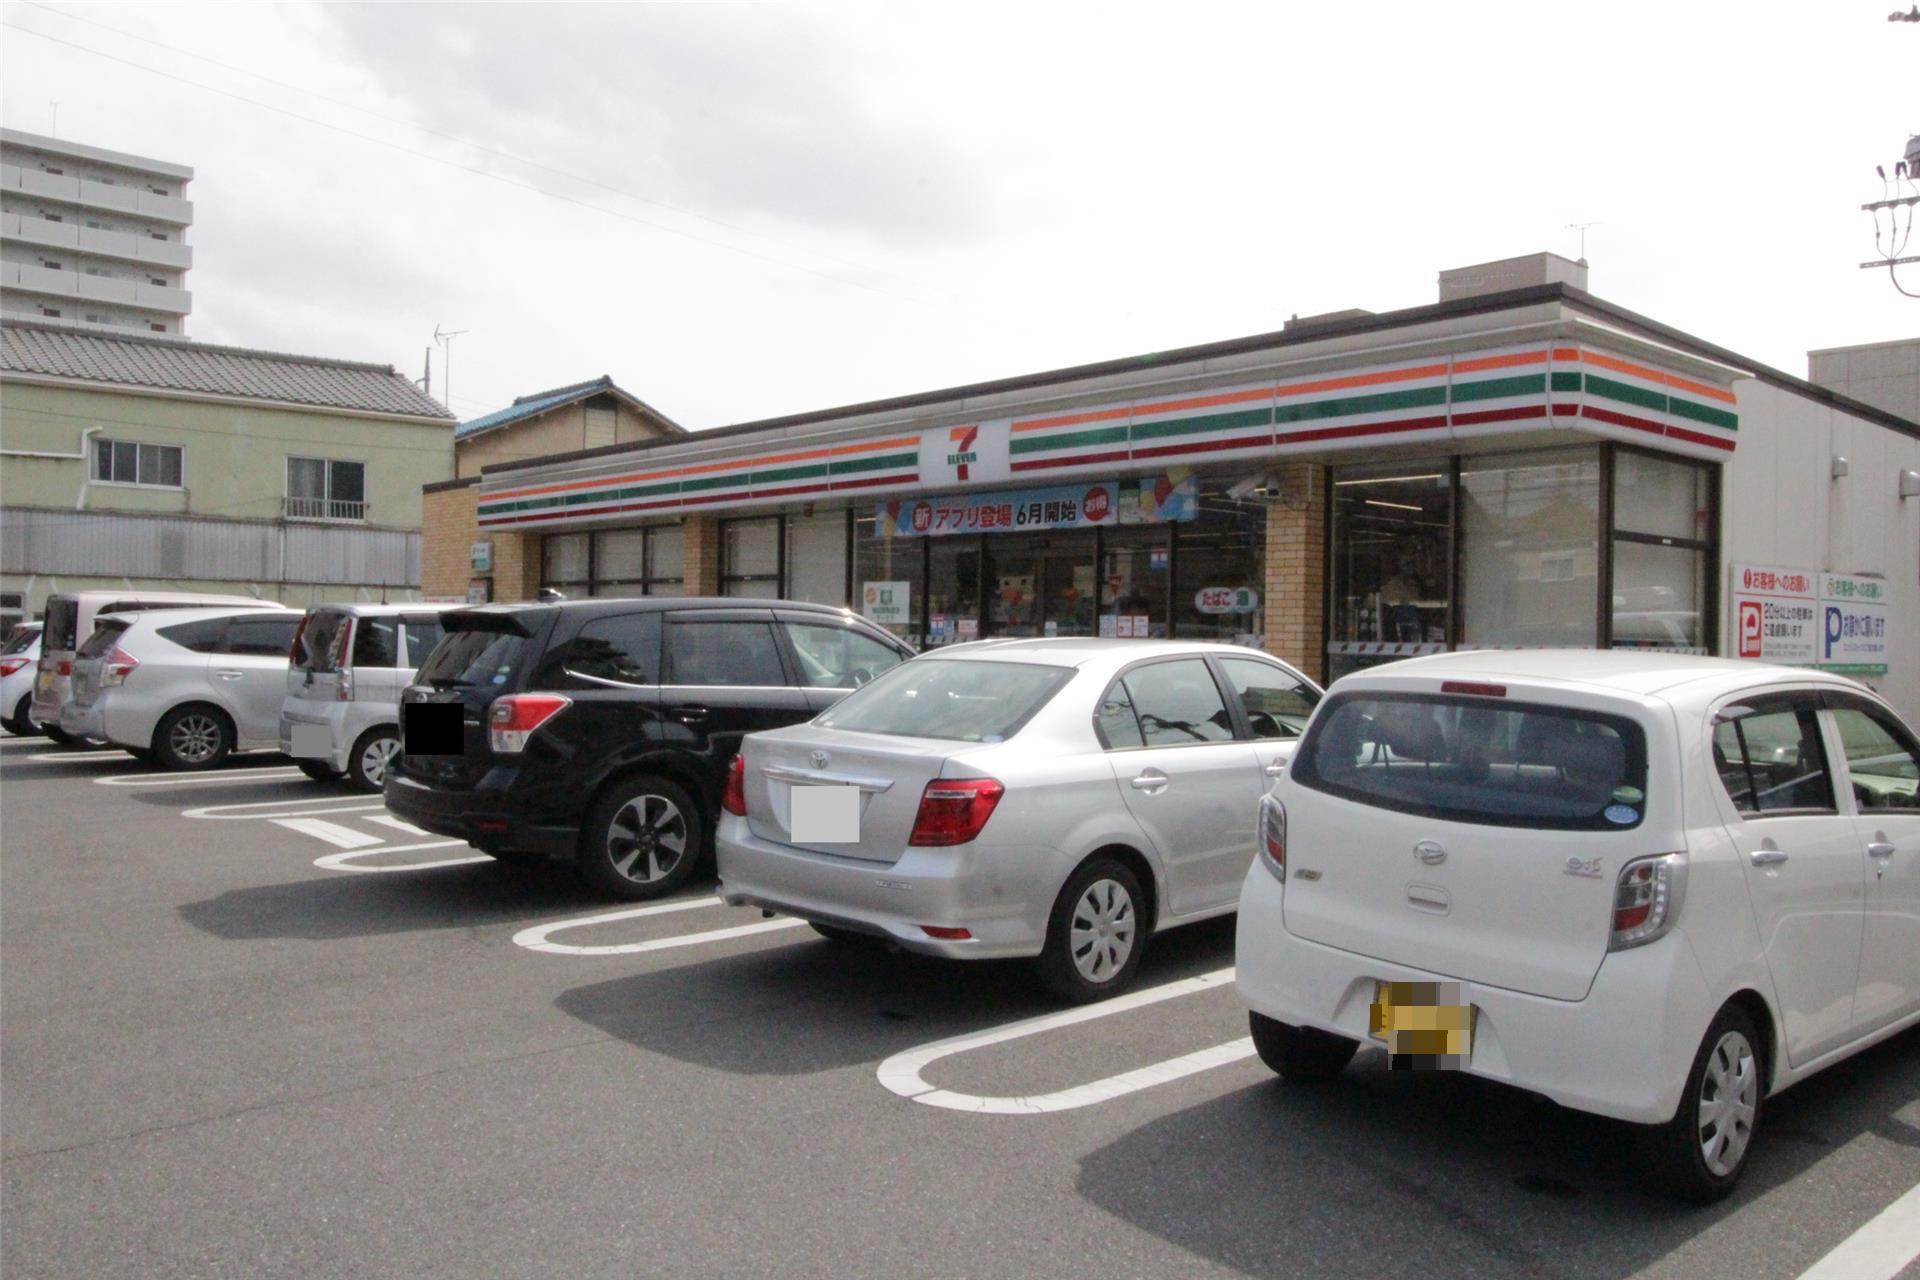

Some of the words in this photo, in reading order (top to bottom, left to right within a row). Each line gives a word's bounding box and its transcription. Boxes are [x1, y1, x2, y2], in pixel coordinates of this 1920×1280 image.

[949, 425, 978, 481] 7
[914, 506, 931, 530] 新
[935, 503, 1012, 530] アプリ登場
[1016, 500, 1077, 526] 6月開始
[1202, 591, 1231, 607] たばこ
